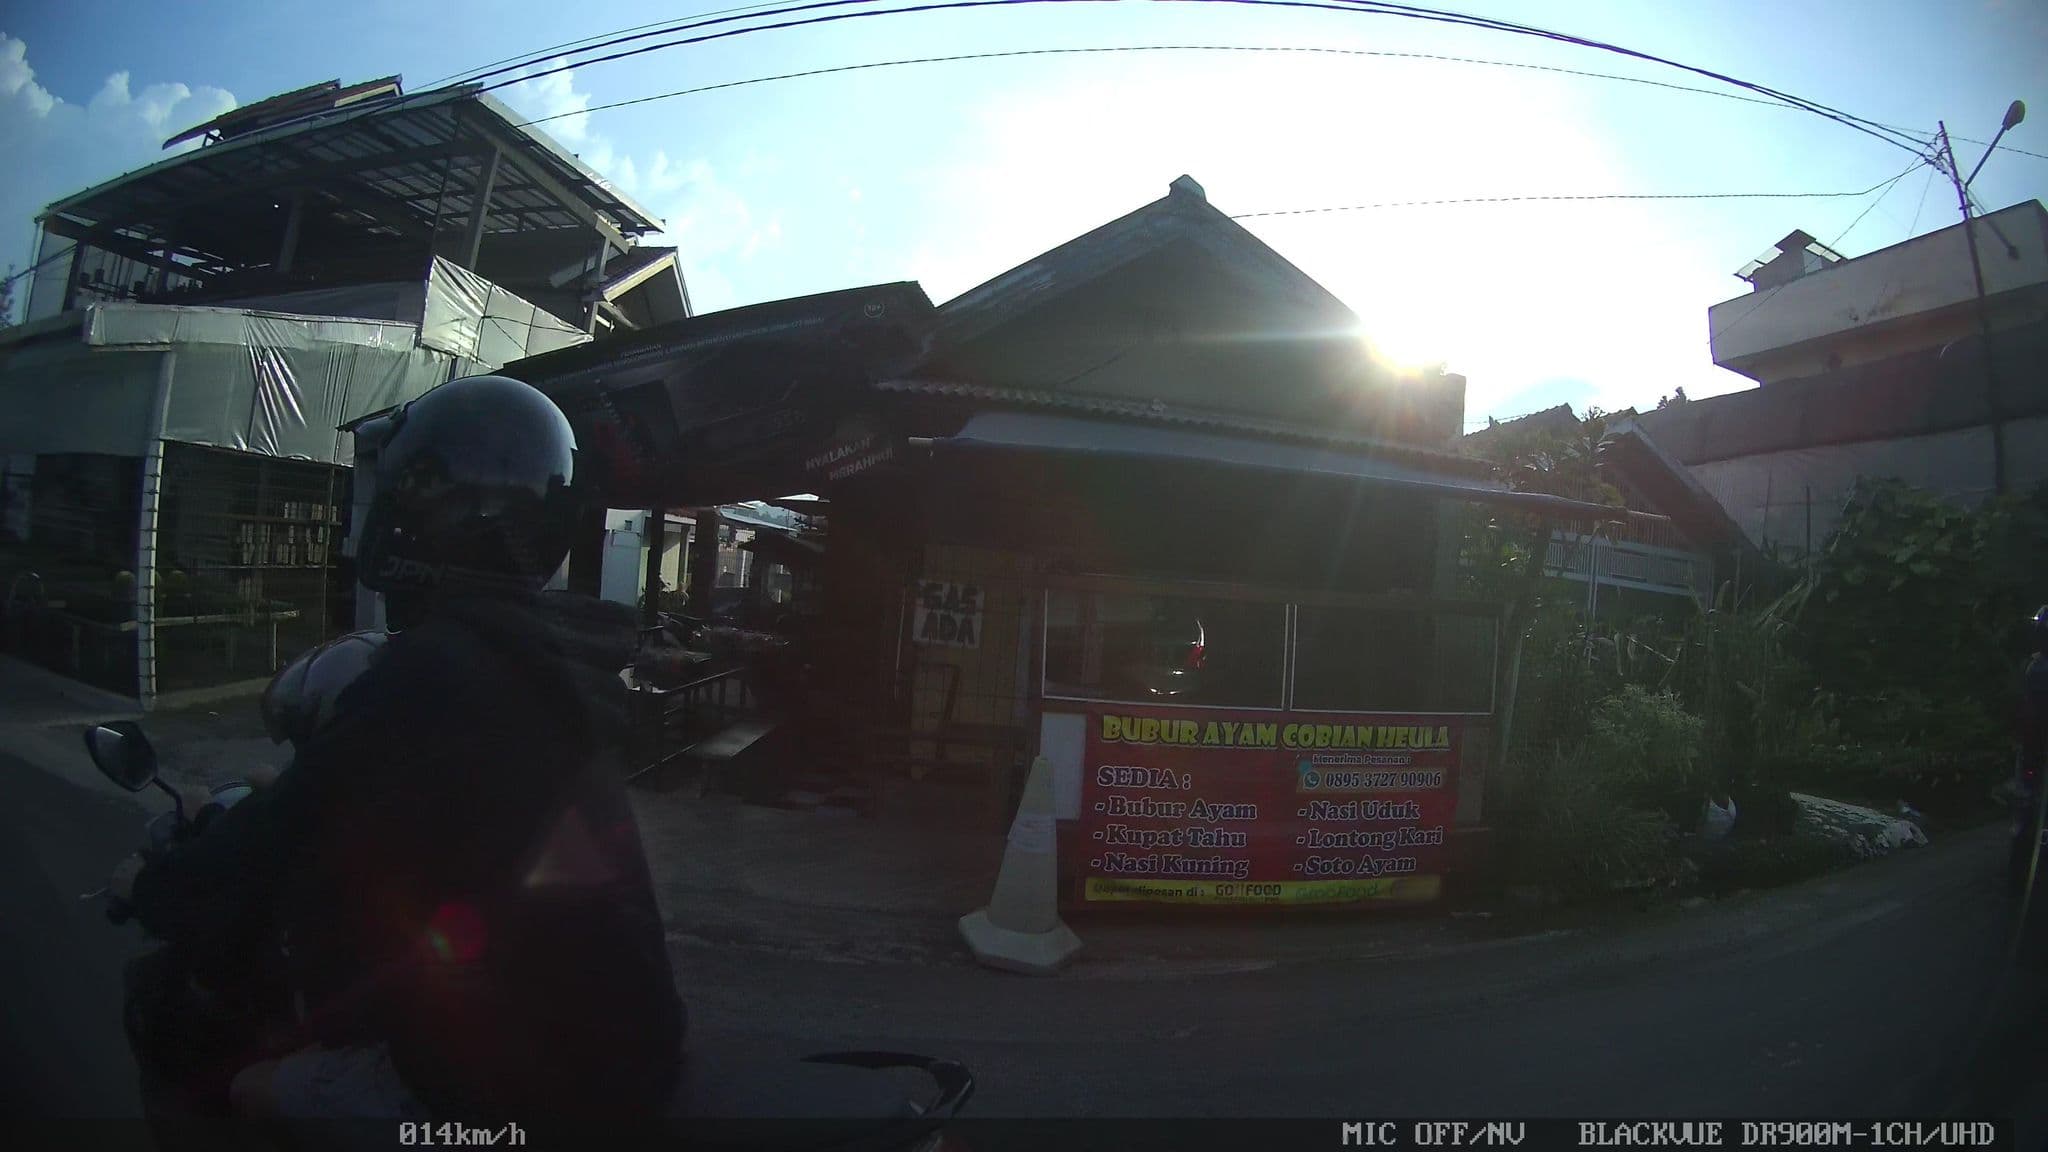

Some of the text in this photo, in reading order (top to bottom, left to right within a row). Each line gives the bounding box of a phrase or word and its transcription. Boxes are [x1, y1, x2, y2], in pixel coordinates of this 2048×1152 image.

[920, 611, 975, 645] ADA
[1102, 715, 1199, 745] BUBUR
[1203, 721, 1280, 748] AYAM
[1282, 723, 1373, 750] COBIAN
[1097, 765, 1178, 789] SEDIA
[1325, 771, 1442, 788] 0895 3727 90906
[1108, 796, 1187, 818] Bubur
[1189, 798, 1257, 822] Ayam
[1309, 801, 1358, 820] Nasi
[1361, 800, 1420, 820] Uduk
[1105, 824, 1184, 848] Kupat
[1186, 827, 1247, 848] Tahu
[1308, 828, 1397, 849] Lontong
[1399, 825, 1443, 846] Kari
[1104, 852, 1158, 873] Nasi
[1161, 855, 1249, 878] Kuning
[1304, 856, 1354, 875] Soto
[1357, 854, 1416, 876] Ayam
[1246, 884, 1282, 897] FOOD
